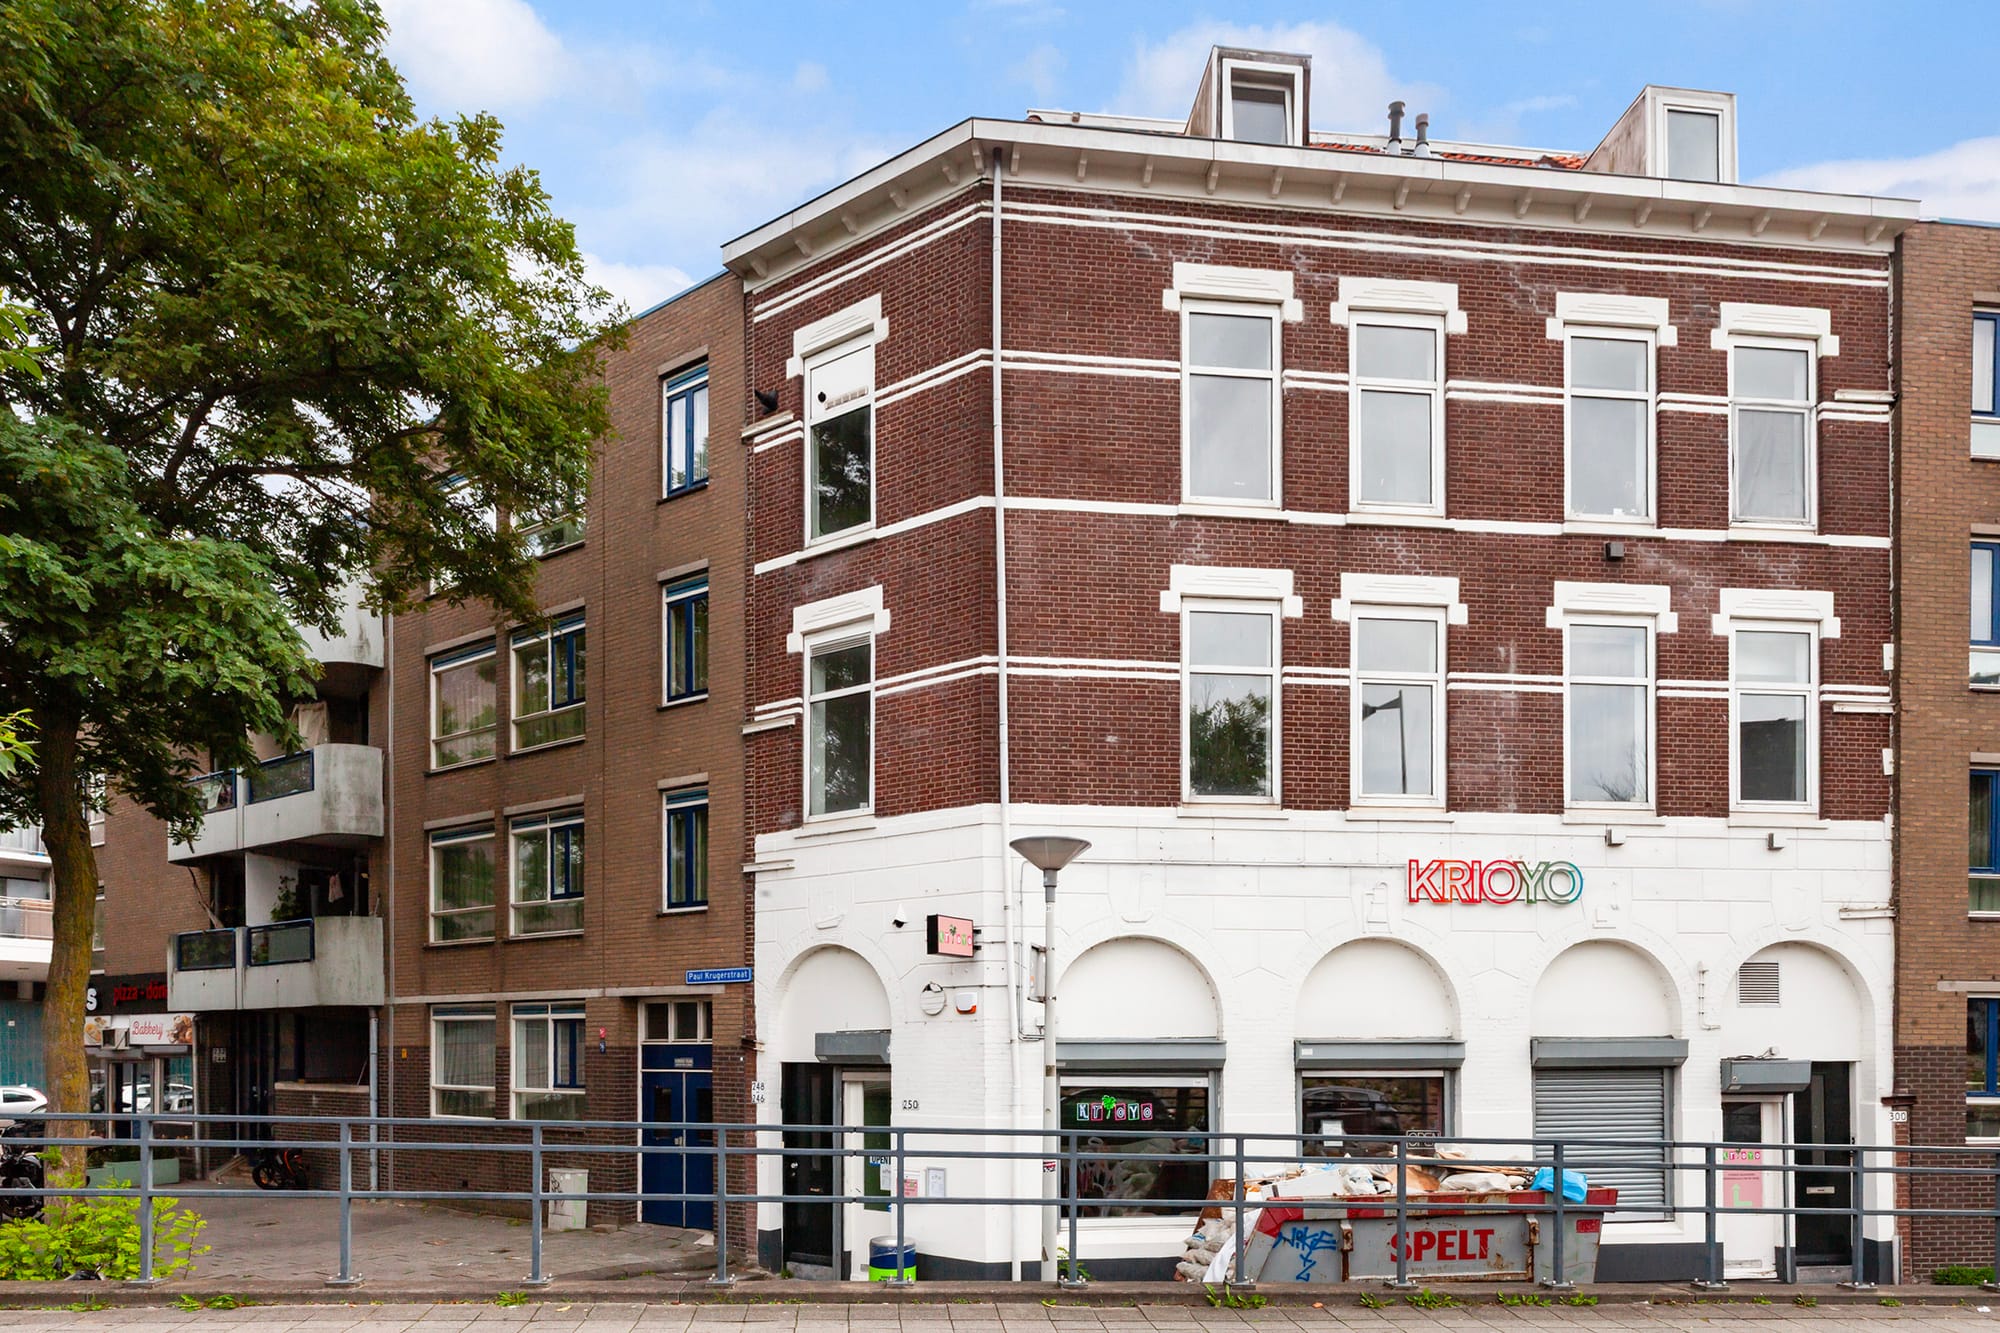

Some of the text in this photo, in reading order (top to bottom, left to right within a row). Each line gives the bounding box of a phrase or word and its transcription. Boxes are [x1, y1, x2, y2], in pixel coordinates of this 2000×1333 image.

[1408, 859, 1583, 905] KRIOYO
[689, 970, 748, 981] Paul Krugerstraat
[113, 982, 138, 1006] pizza
[752, 1081, 765, 1091] 248
[902, 1099, 920, 1110] 250
[1889, 1111, 1907, 1121] 300
[1390, 1229, 1495, 1262] SPELT
